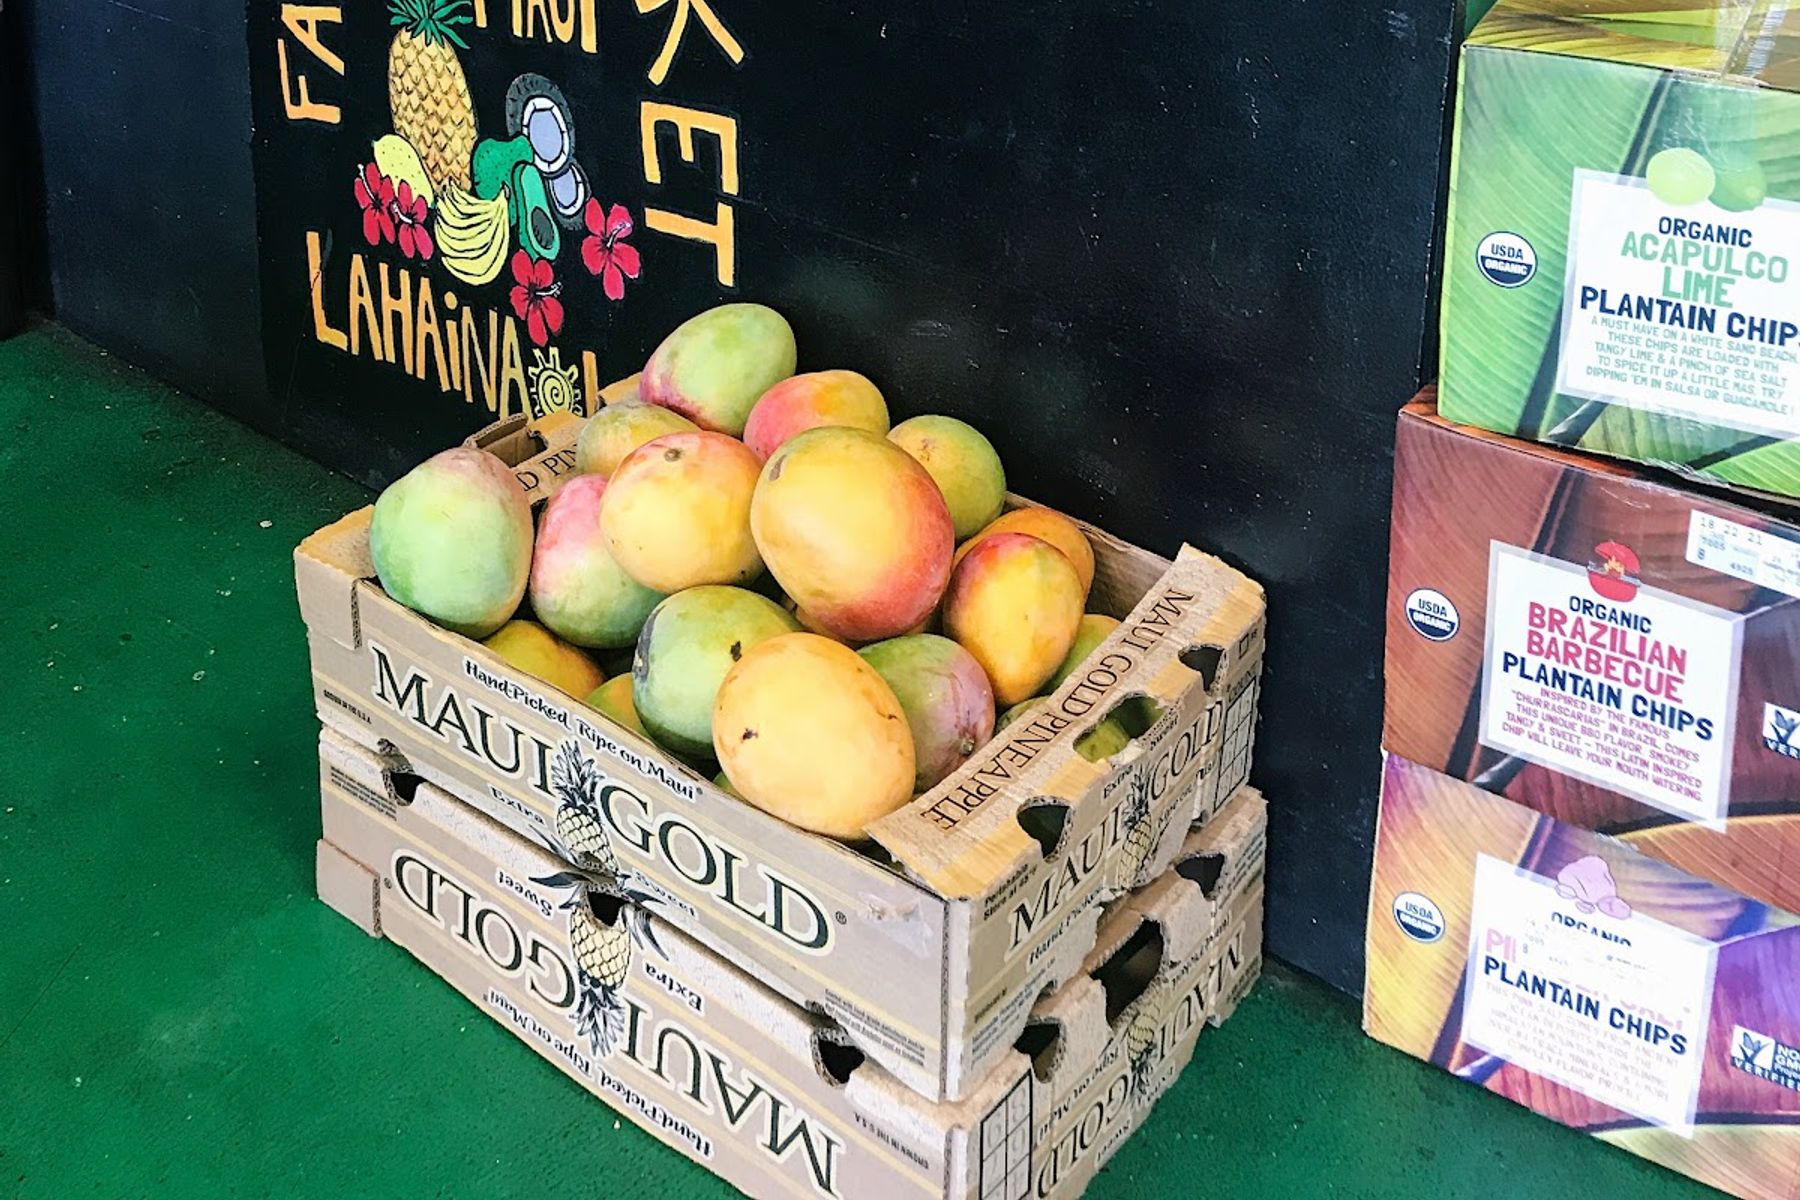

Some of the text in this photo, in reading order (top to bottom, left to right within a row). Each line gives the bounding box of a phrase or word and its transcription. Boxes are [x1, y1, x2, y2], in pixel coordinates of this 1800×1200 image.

[1490, 243, 1524, 261] USDA
[1620, 231, 1789, 284] ACAPULCO
[1658, 216, 1753, 248] ORGANIC
[1580, 285, 1800, 348] PLANTAIN CHIP
[1662, 265, 1737, 309] LIME
[1608, 330, 1642, 347] THESE
[1645, 338, 1679, 354] CHIPS
[1681, 346, 1703, 360] ARE
[1706, 350, 1750, 368] LOADED
[1586, 366, 1627, 383] DIPPING
[1665, 380, 1700, 398] SALSA
[1121, 586, 1195, 654] MAUI
[1418, 597, 1448, 618] USDA
[1527, 600, 1688, 677] BRAZILIAN
[1568, 595, 1652, 635] ORGANIC
[1062, 652, 1134, 726] GOLD
[1502, 651, 1715, 743] PLANTAIN CHIPS
[1526, 629, 1685, 704] BARBECUE
[1540, 686, 1588, 712] INSPIRED
[1606, 708, 1627, 724] THE
[1628, 717, 1671, 741] FAMOUS
[576, 718, 617, 752] Ripe
[643, 760, 695, 801] Maui
[919, 710, 1071, 831] PINEAPPLE
[1501, 721, 1526, 738] CHIP
[1551, 738, 1583, 759] LEAVE
[1586, 750, 1613, 769] YOUR
[1615, 759, 1650, 782] MOUTH
[370, 646, 831, 950] MAUI GOLD
[491, 786, 545, 825] Extra
[1009, 800, 1124, 952] MAUI
[1151, 700, 1224, 801] GOLD
[393, 854, 579, 1011] GOLD
[1405, 901, 1434, 921] USDA
[1483, 954, 1601, 1021] PLANTAIN
[1608, 1006, 1689, 1056] CHIPS
[620, 997, 840, 1198] MAUI
